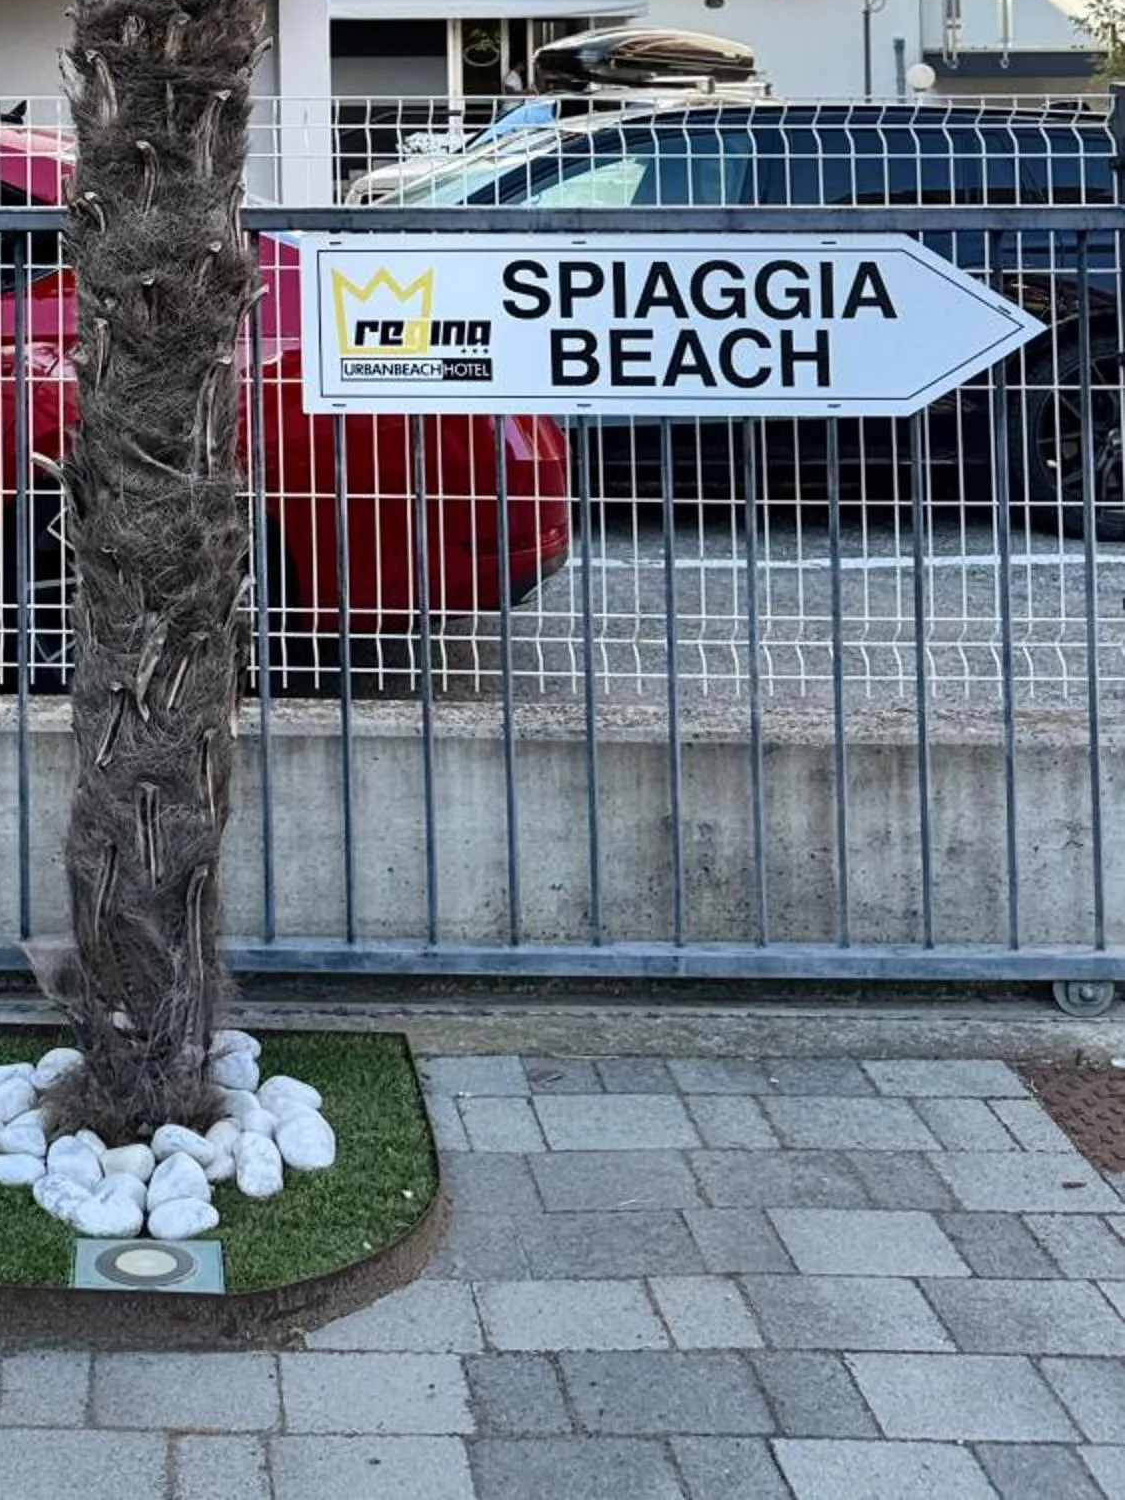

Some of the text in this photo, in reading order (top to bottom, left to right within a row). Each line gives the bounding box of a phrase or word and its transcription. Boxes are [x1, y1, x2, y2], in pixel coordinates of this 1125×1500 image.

[502, 259, 897, 319] SPIAGGIA
[443, 362, 491, 377] HOTEL
[550, 328, 831, 387] BEACH
